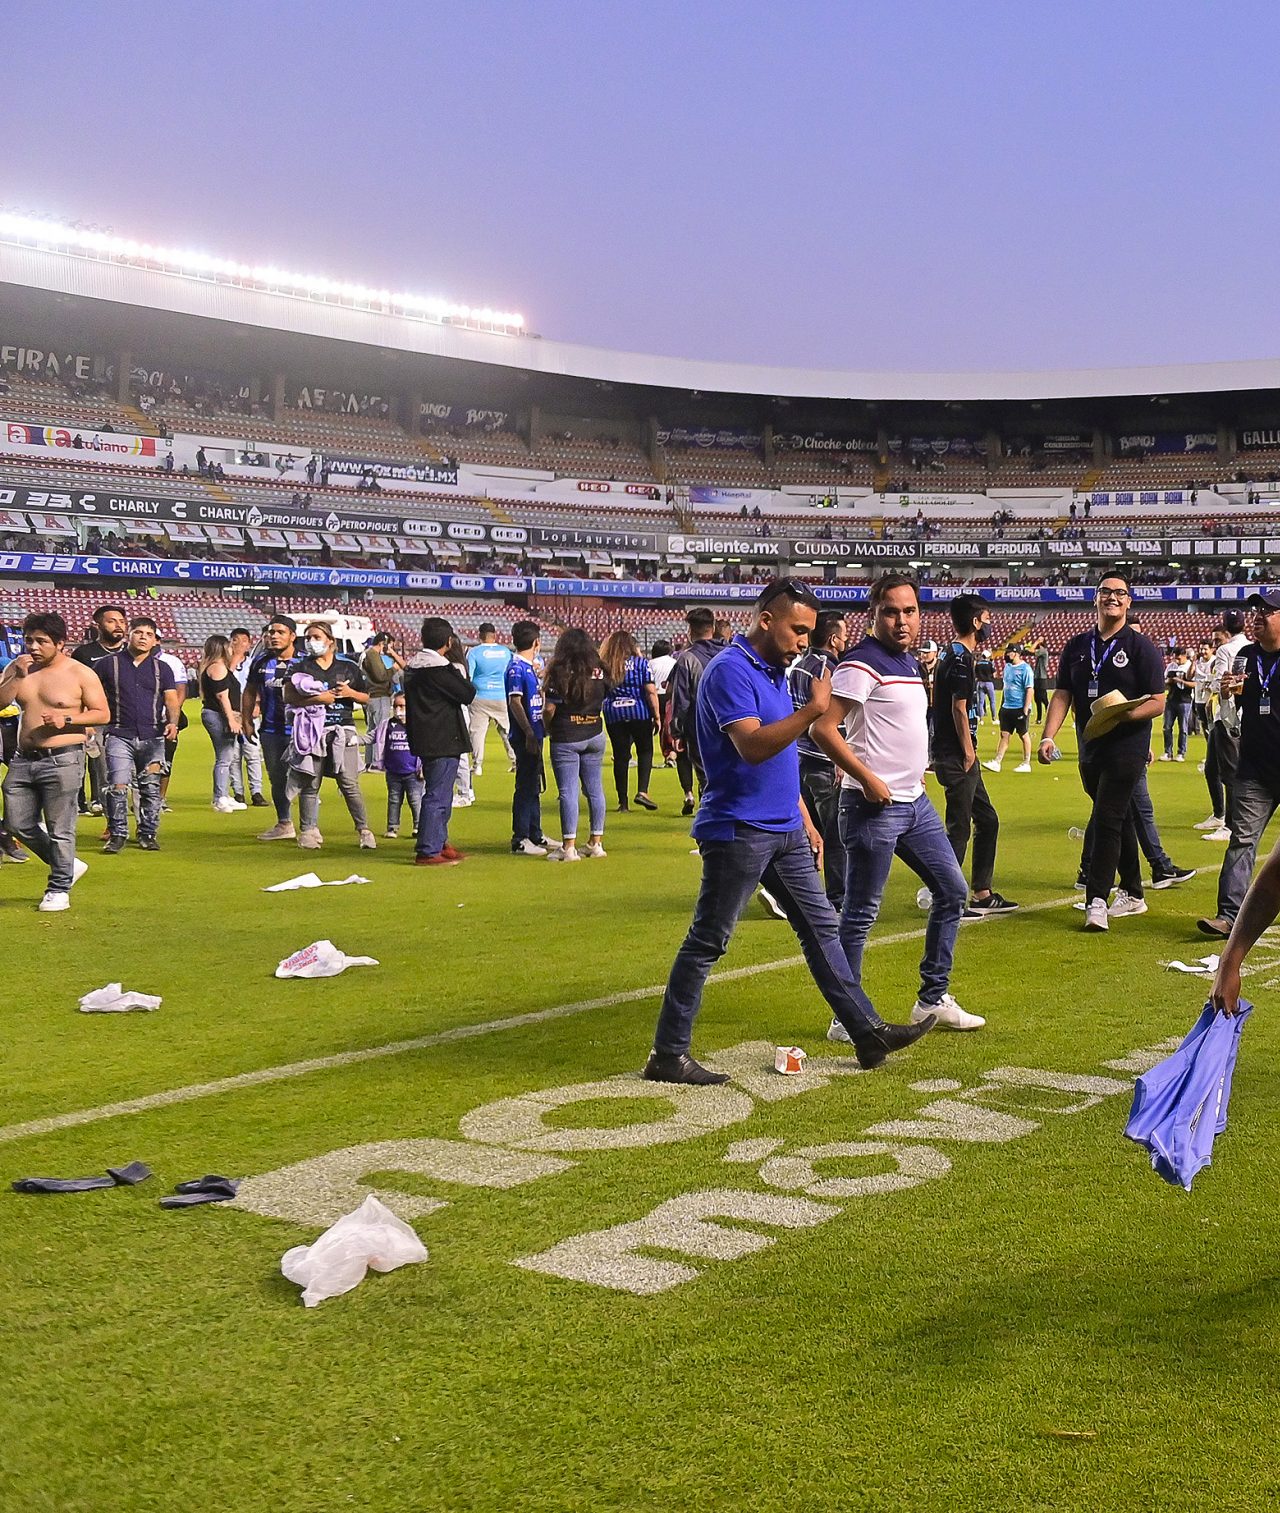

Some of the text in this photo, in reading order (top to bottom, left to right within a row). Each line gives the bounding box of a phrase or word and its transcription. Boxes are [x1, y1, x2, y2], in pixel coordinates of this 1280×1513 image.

[109, 499, 160, 514] CHARLY
[199, 505, 246, 521] CHARLY
[541, 530, 568, 542] Los
[574, 532, 649, 547] Laureles
[686, 537, 779, 555] caliente.mx
[795, 541, 915, 558] CIUDAD MADERAS
[925, 543, 980, 555] PERDURA
[987, 543, 1041, 555] PERDURA
[112, 561, 163, 574] CHARLY
[202, 565, 248, 579] CHARLY
[548, 579, 656, 594] Los Laureles
[674, 585, 728, 597] caliente.mx
[995, 588, 1041, 599] PERDURA
[814, 588, 857, 600] CIUDAD
